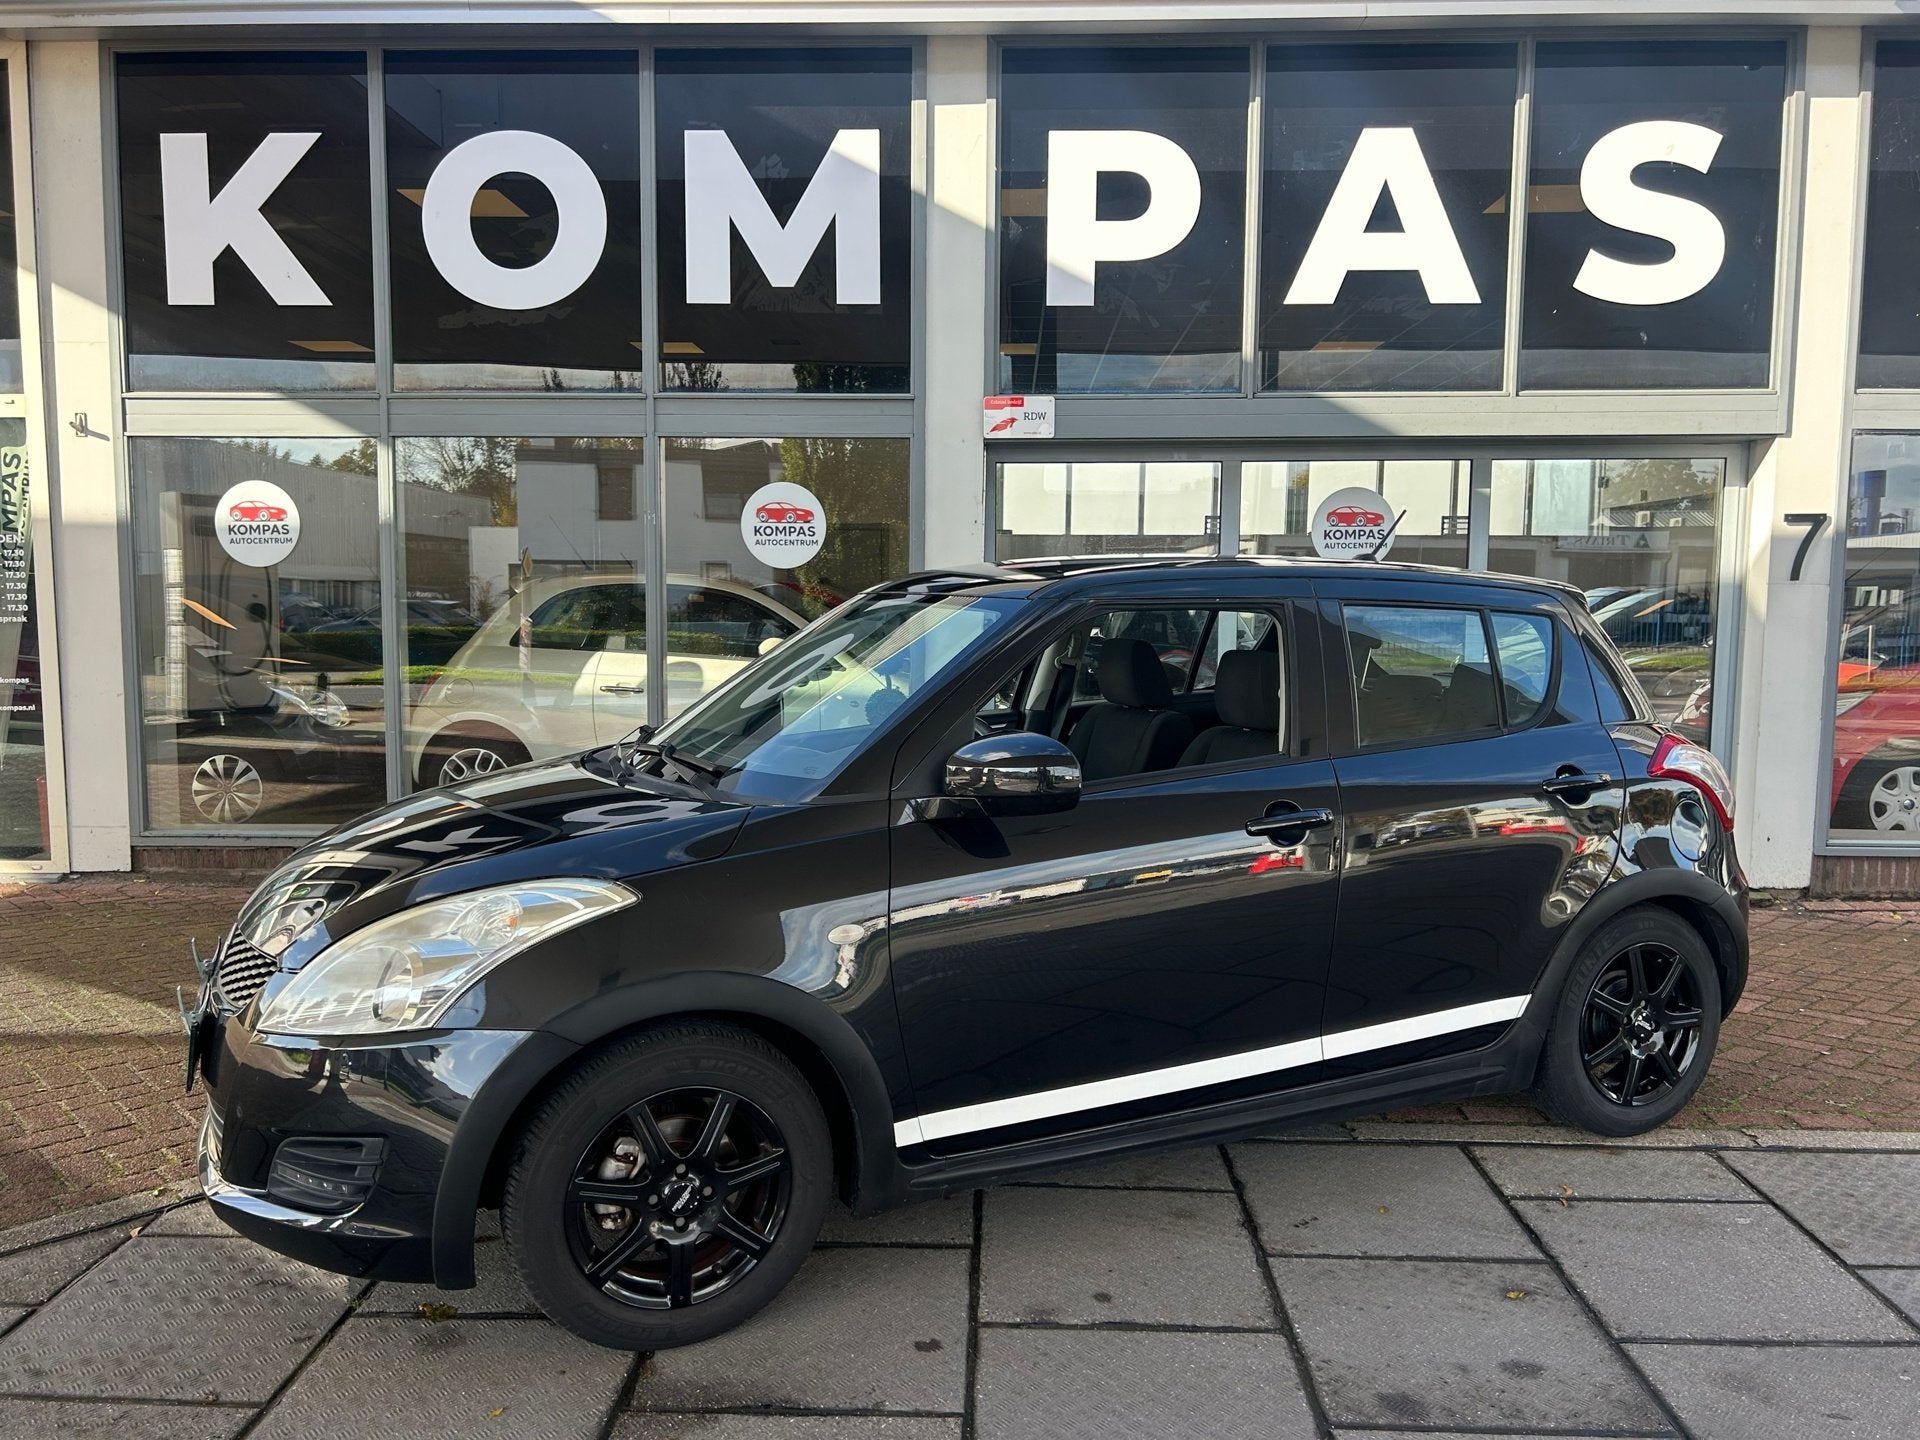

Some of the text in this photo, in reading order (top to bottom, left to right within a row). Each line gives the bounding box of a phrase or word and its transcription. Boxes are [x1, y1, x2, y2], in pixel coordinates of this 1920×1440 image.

[1023, 412, 1047, 421] RDW
[228, 524, 290, 536] KOMPAS
[754, 525, 816, 537] KOMPAS
[1323, 529, 1386, 540] KOMPAS
[229, 537, 293, 545] AUTOCENTRUM
[754, 538, 819, 547] AUTOCENTRUM
[1783, 513, 1828, 582] 7
